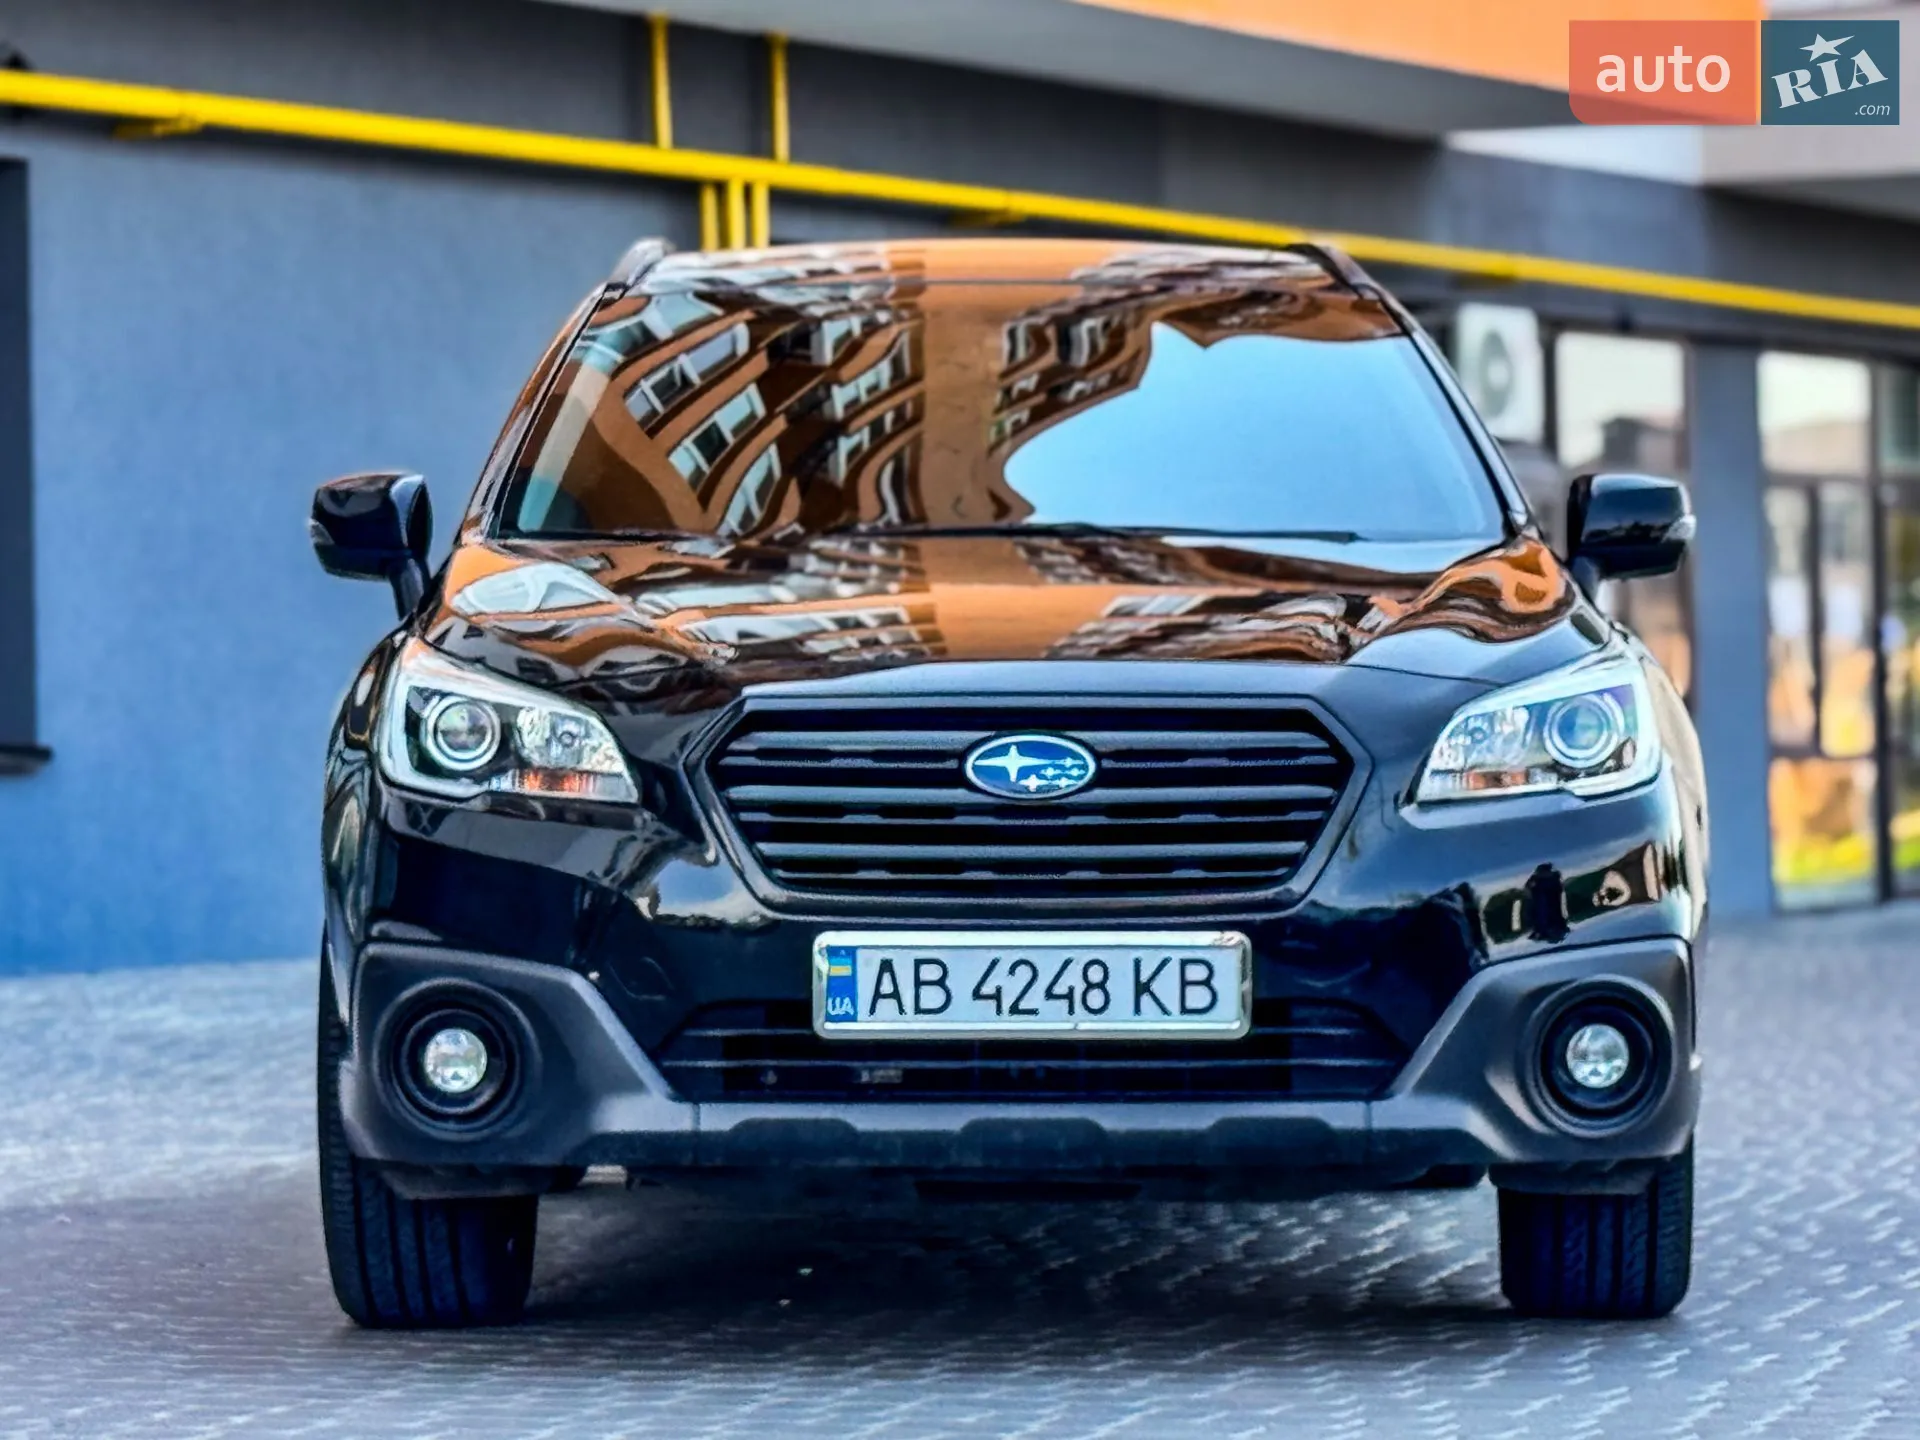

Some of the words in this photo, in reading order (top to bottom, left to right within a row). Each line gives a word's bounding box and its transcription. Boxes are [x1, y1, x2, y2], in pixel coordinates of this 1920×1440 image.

[868, 957, 953, 1016] AB
[971, 956, 1111, 1016] 4248
[1132, 956, 1219, 1016] KB
[827, 996, 855, 1017] UA
